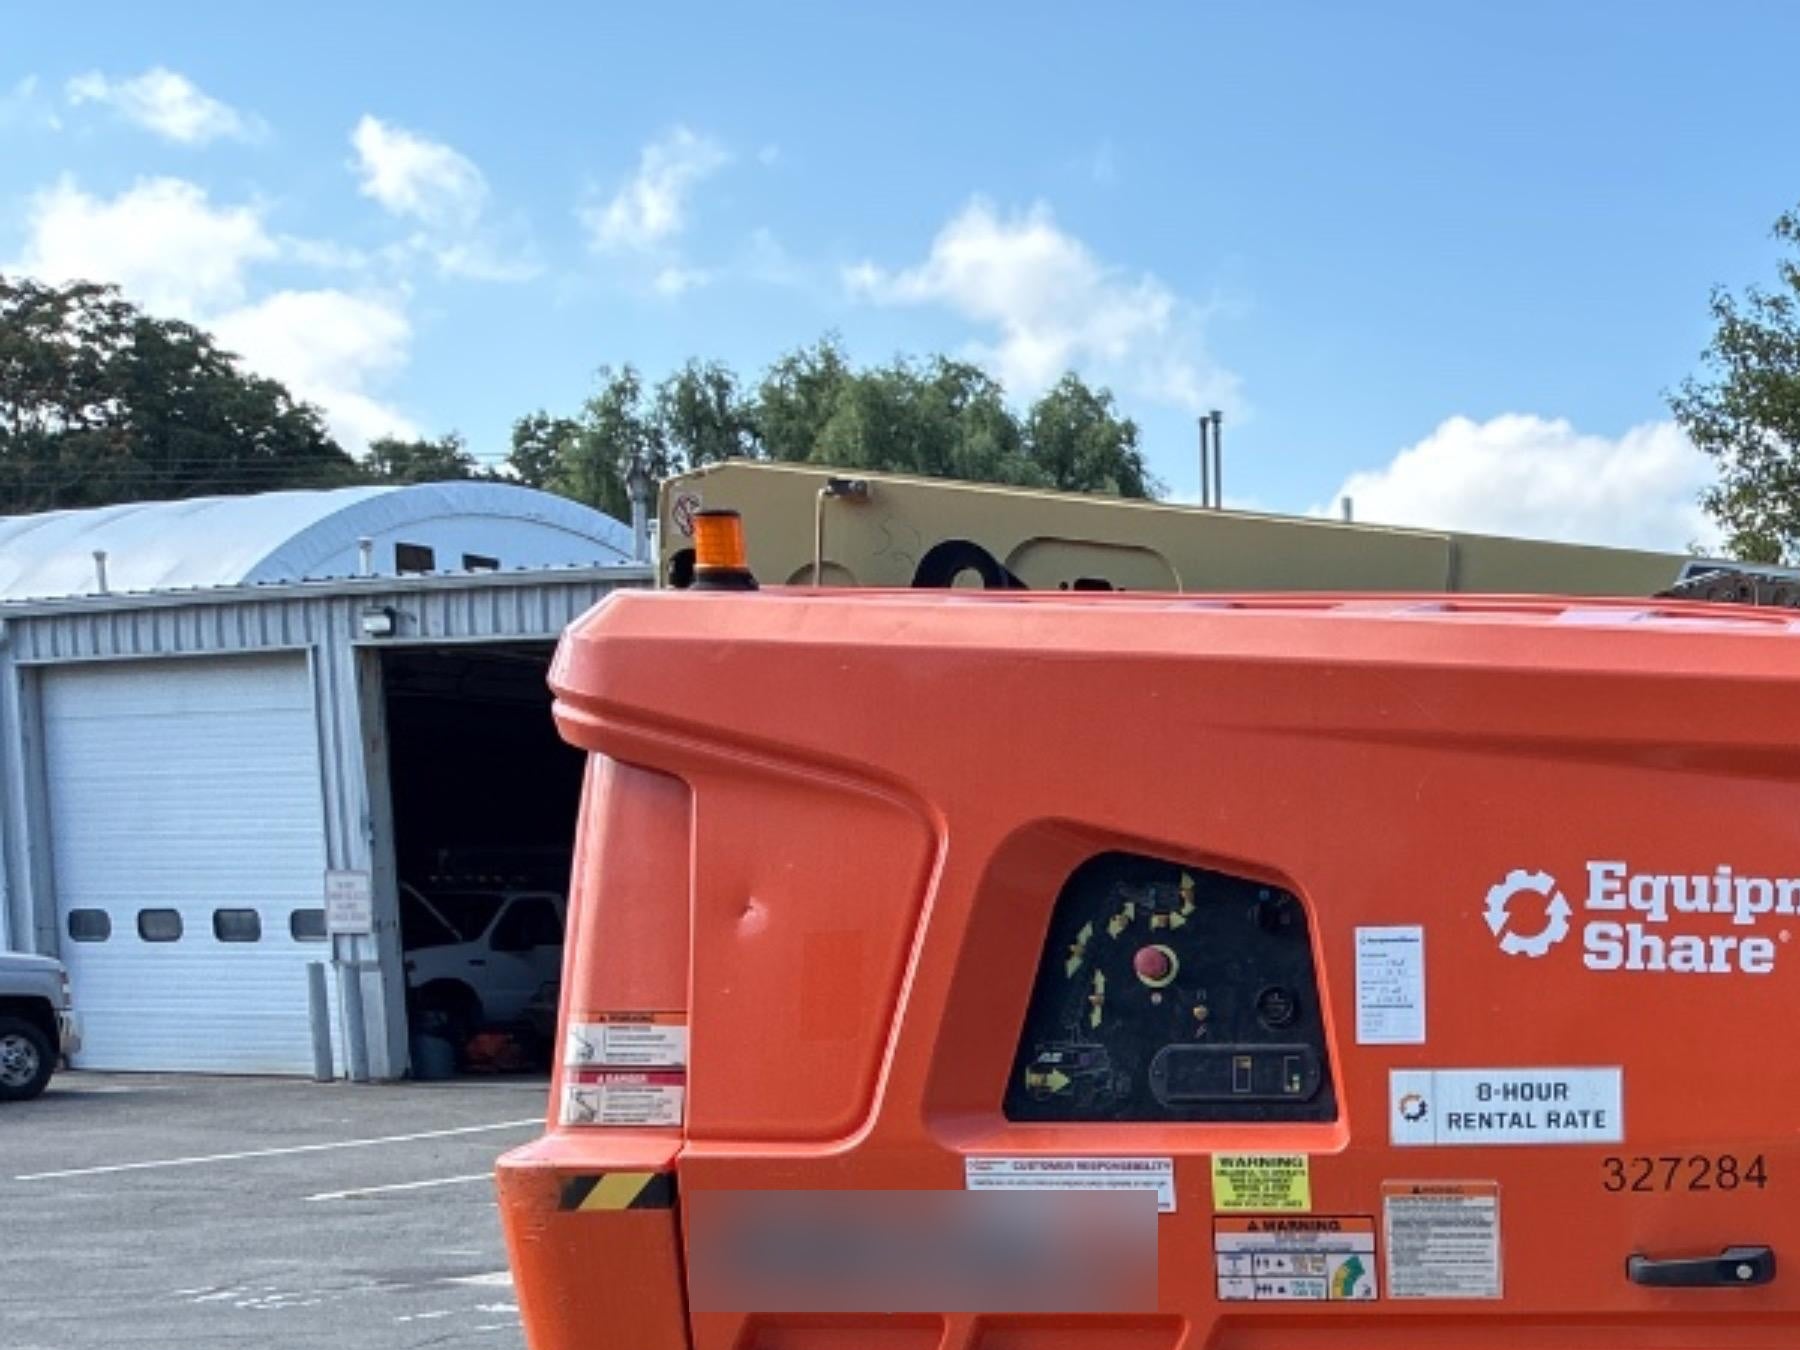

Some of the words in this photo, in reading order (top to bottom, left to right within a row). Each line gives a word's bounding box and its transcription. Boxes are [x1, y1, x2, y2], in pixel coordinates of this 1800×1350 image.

[1477, 1082, 1569, 1102] 8-HOUR
[1447, 1111, 1537, 1131] RENTAL
[1546, 1110, 1607, 1129] RATE
[1602, 1154, 1769, 1192] 327284
[1264, 1220, 1342, 1232] WARNING
